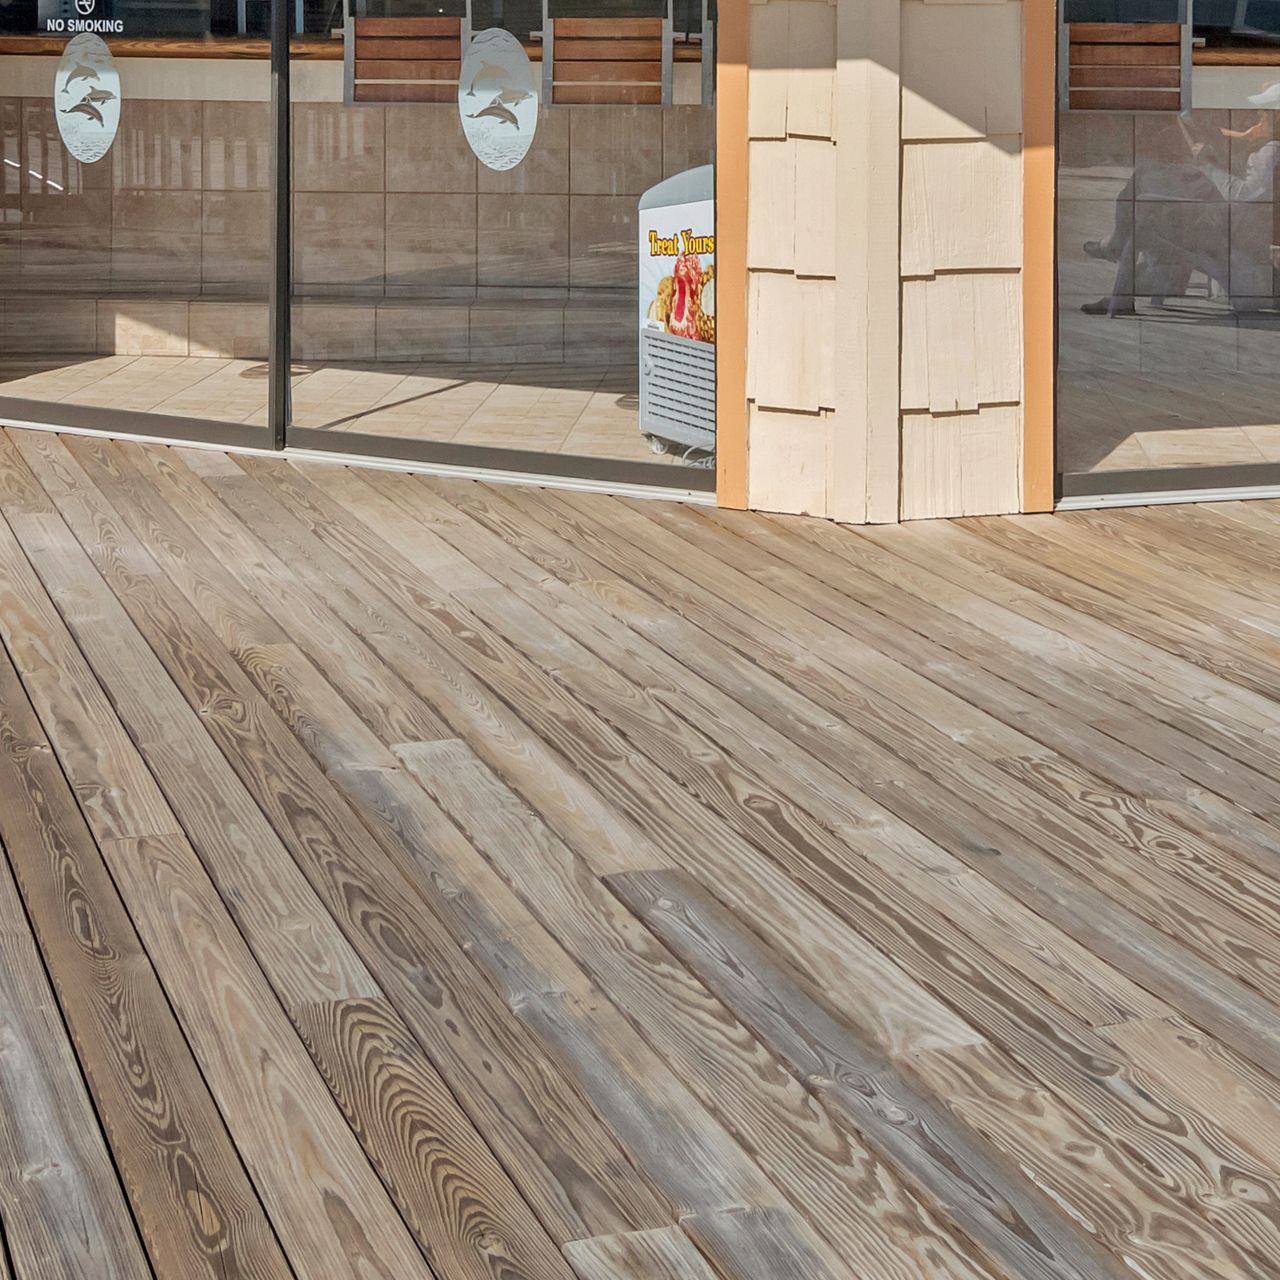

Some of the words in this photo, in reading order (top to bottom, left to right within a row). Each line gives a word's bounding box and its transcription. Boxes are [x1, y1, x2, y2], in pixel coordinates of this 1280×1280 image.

[47, 19, 65, 32] NO
[67, 19, 124, 33] SMOKING
[648, 230, 679, 257] Treat
[680, 228, 715, 255] Yours
